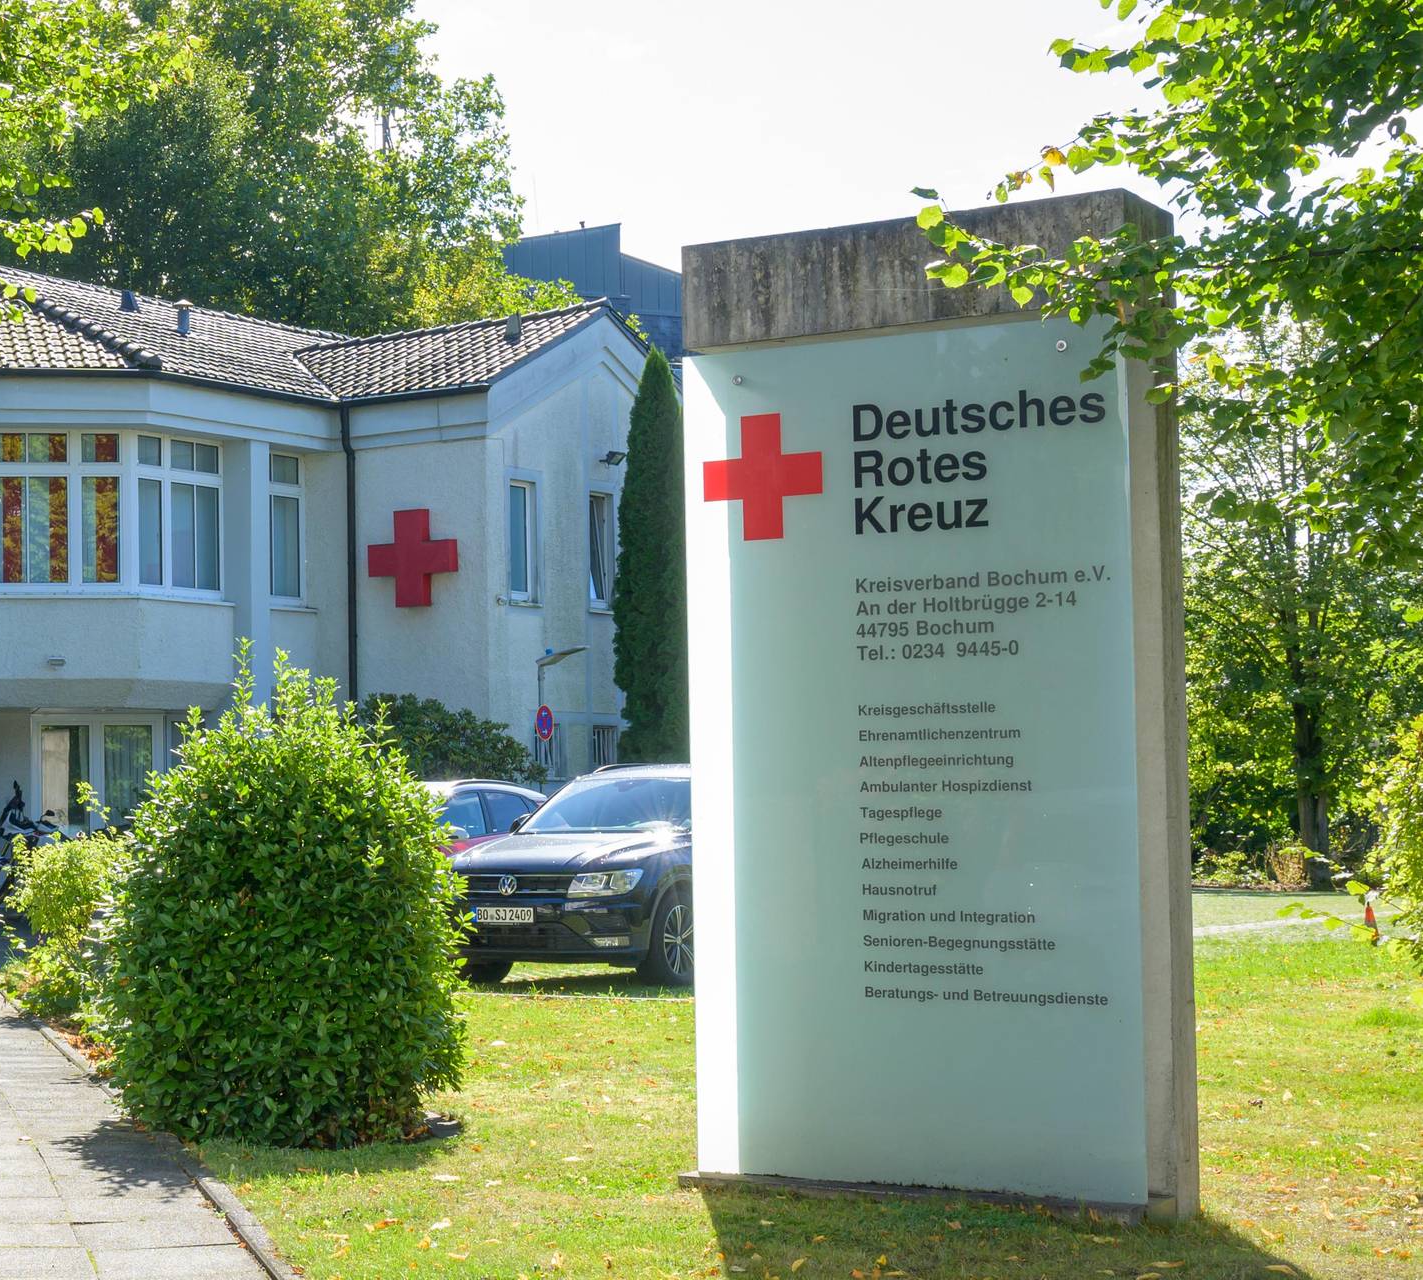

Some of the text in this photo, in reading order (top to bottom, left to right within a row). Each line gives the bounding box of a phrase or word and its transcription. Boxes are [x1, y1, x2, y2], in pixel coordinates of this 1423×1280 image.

[853, 389, 1106, 442] Deutsches
[854, 448, 987, 488] Rotes
[855, 496, 989, 536] Kreuz
[856, 565, 1111, 594] Kreisverband Bochum e.V.
[856, 591, 1077, 616] An der Holtbrügge 2-14
[856, 619, 995, 639] 44795 Bochum
[857, 640, 1019, 661] Tel.: 0234 9445-0
[858, 701, 996, 718] Kreisgeschäftsstelle
[858, 728, 1021, 742] Ehrenamtlichenzentrum
[859, 754, 1014, 769] Altenpflegeeinrichtung
[860, 780, 1032, 795] Ambulanter Hospizdienst
[860, 806, 942, 822] Tagespflege
[859, 832, 949, 847] Pflegeschule
[861, 858, 958, 871] Alzheimerhilfe
[862, 884, 937, 897] Hausnotruf
[477, 908, 489, 921] BO
[863, 909, 1036, 926] Migration und Integration
[863, 935, 1056, 953] Senioren-Begegnungsstätte
[864, 961, 984, 977] Kindertagesstätte
[865, 986, 1109, 1007] Beratungs- und Betreuungsdienste
